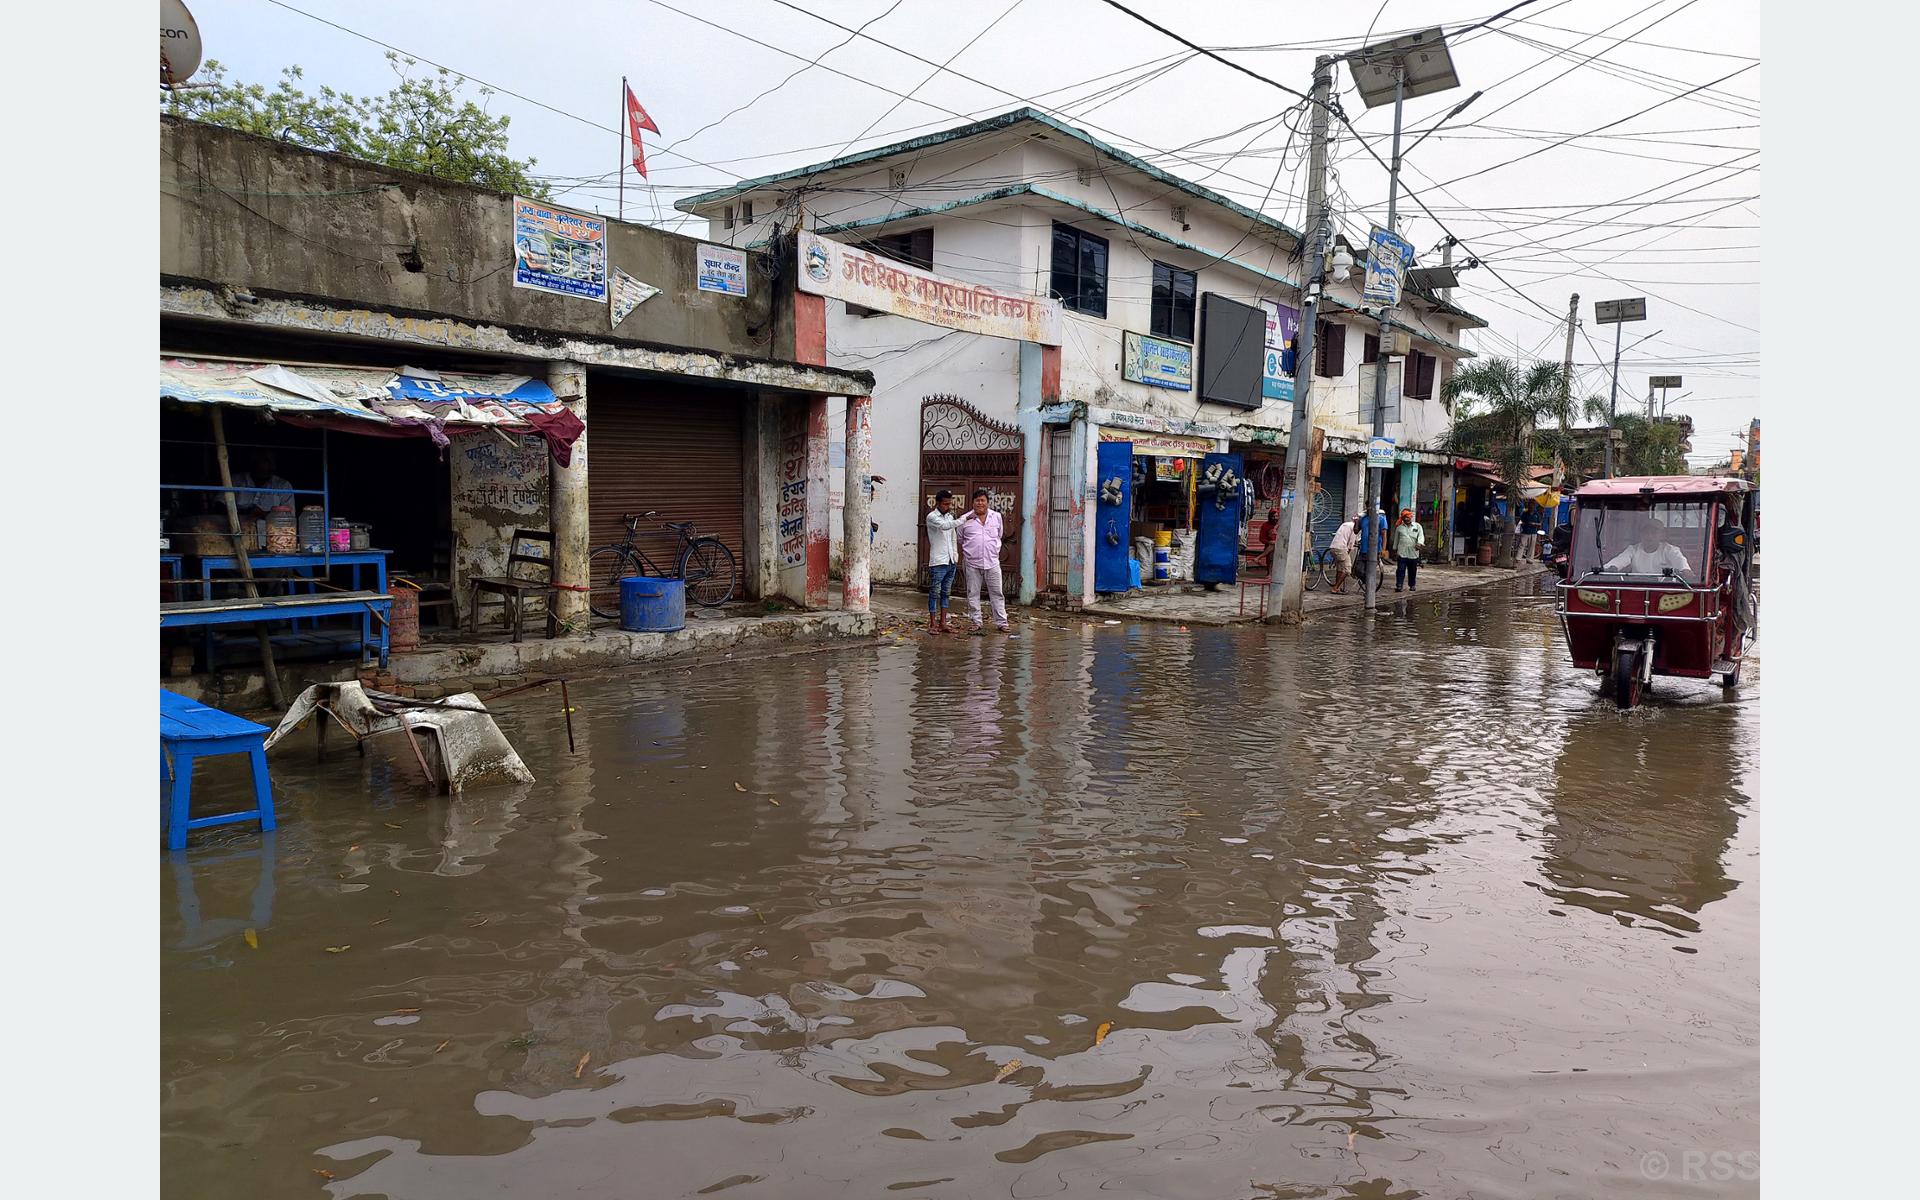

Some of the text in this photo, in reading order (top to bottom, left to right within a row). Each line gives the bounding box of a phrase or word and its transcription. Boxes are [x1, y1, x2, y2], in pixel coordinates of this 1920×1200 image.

[704, 259, 740, 273] सुधार केन्द्र
[840, 251, 913, 296] जलेश्वर
[913, 275, 1034, 321] नगरपालिका
[781, 480, 806, 498] हेयर
[780, 516, 804, 538] सैलून
